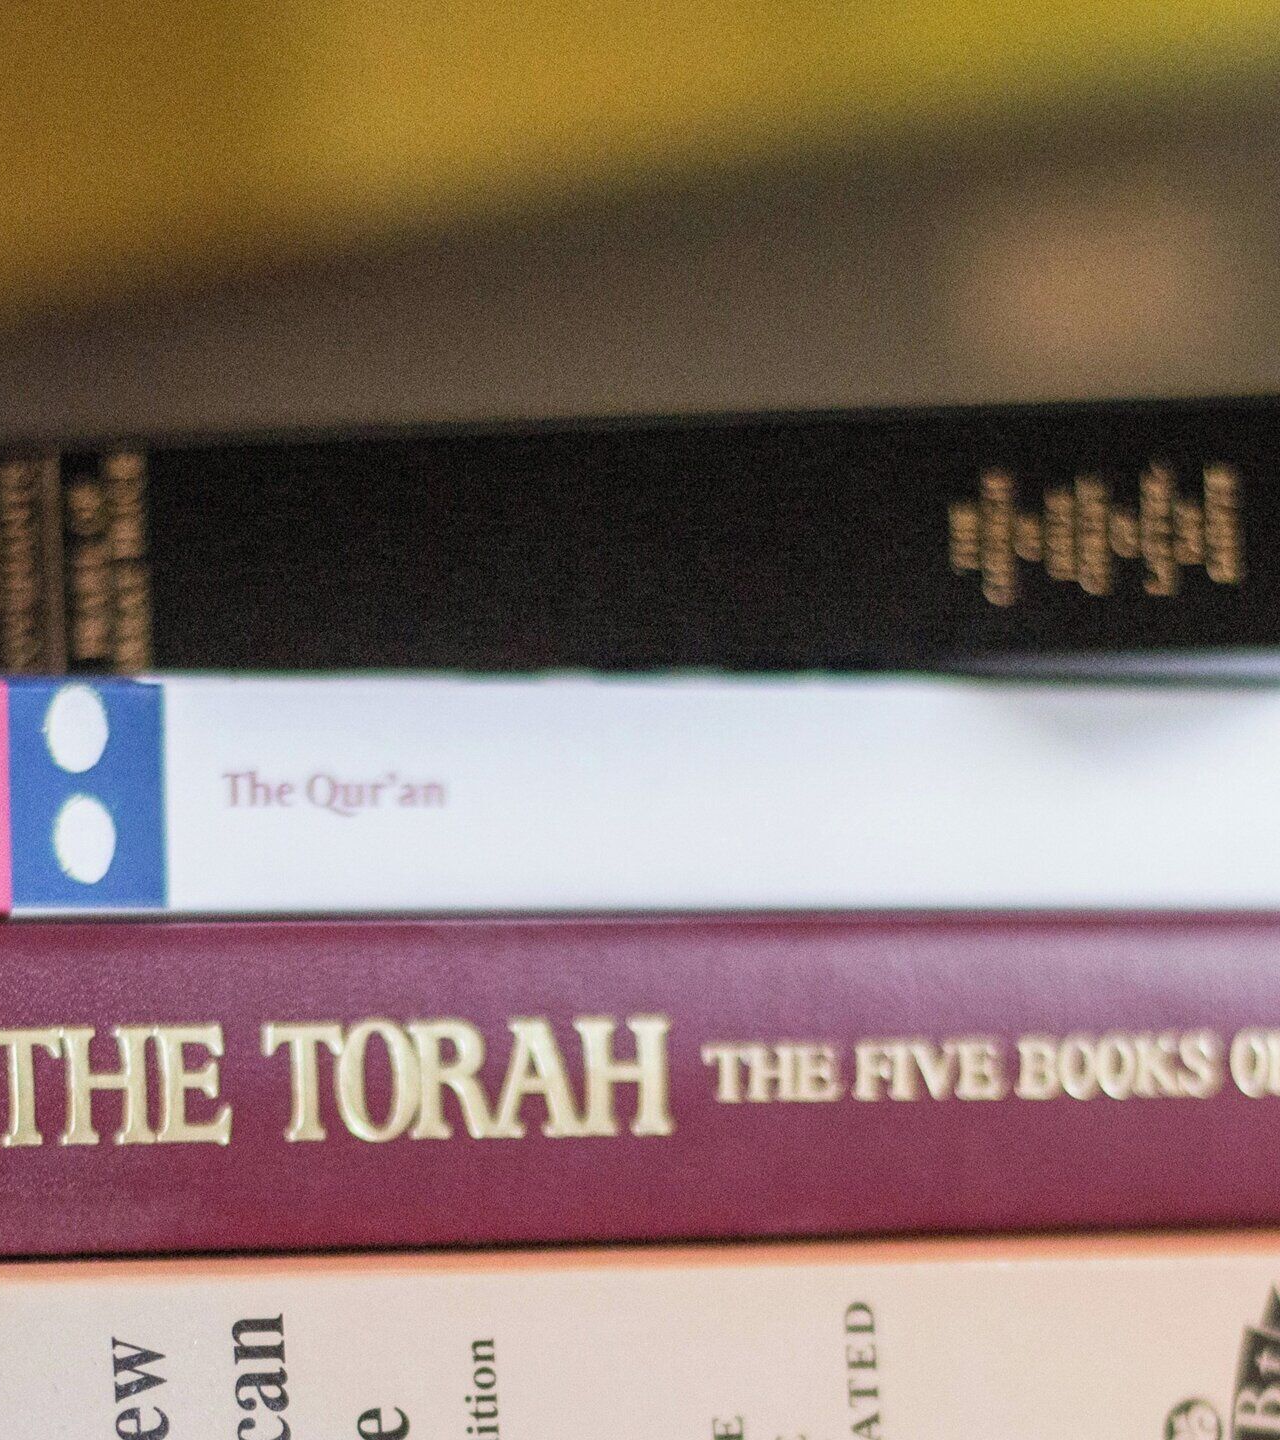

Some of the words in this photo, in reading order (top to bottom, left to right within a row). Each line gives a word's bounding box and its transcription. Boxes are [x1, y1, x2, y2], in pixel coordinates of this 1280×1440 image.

[221, 770, 294, 807] The
[260, 1016, 676, 1143] TORAH
[702, 1038, 842, 1104] THE
[853, 1034, 1006, 1101] FIVE
[1014, 1029, 1222, 1101] BOOKS
